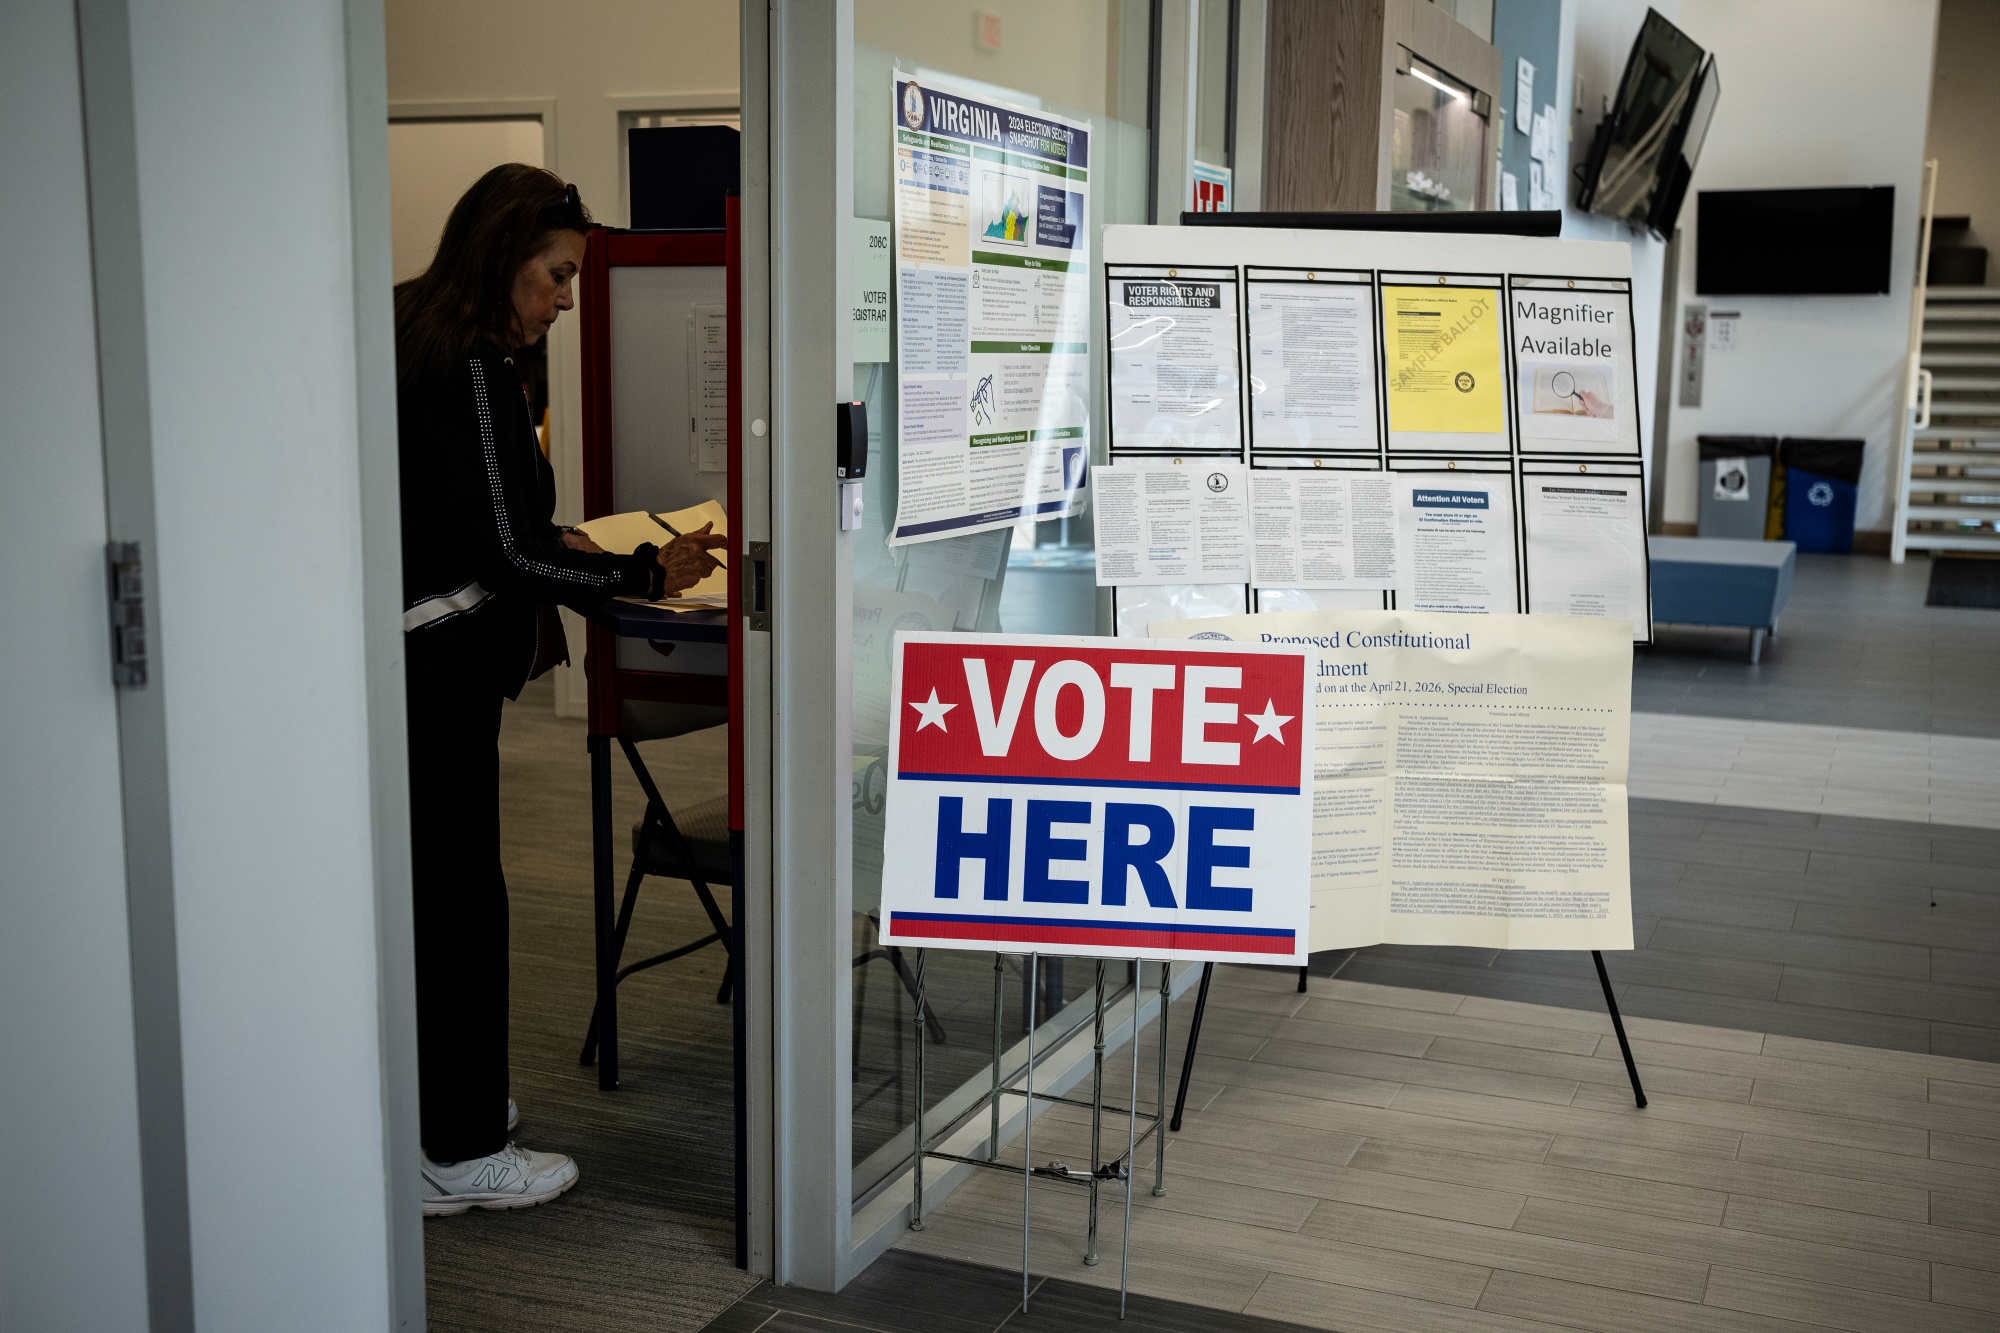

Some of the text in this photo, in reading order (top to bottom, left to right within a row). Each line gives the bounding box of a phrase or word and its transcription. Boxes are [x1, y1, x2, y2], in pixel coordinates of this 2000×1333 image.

[930, 96, 1002, 142] VIRGINIA
[1008, 116, 1074, 145] 2024 ELECTION SECURITY
[1009, 131, 1066, 156] SNAPSHOT FOR VOTERS
[869, 235, 887, 248] 206C
[864, 291, 887, 304] VOTER
[1128, 286, 1214, 297] VOTER RIGHTS AND
[1129, 297, 1210, 307] RESPONSIBILITIES
[1518, 301, 1614, 325] Magnifier
[1390, 340, 1444, 391] SAMPLE
[1440, 298, 1490, 346] BALLOT
[1520, 335, 1612, 358] Available
[1346, 630, 1471, 650] Constitutional
[1324, 685, 1336, 693] on
[1340, 683, 1348, 693] at
[1351, 682, 1366, 692] the
[1369, 680, 1393, 694] April
[1395, 681, 1412, 693] 21,
[1414, 682, 1444, 693] 2026,
[1447, 682, 1483, 695] Special
[1486, 683, 1528, 695] Election
[962, 658, 1243, 766] VOTE
[934, 796, 1255, 912] HERE
[471, 1163, 510, 1190] N
